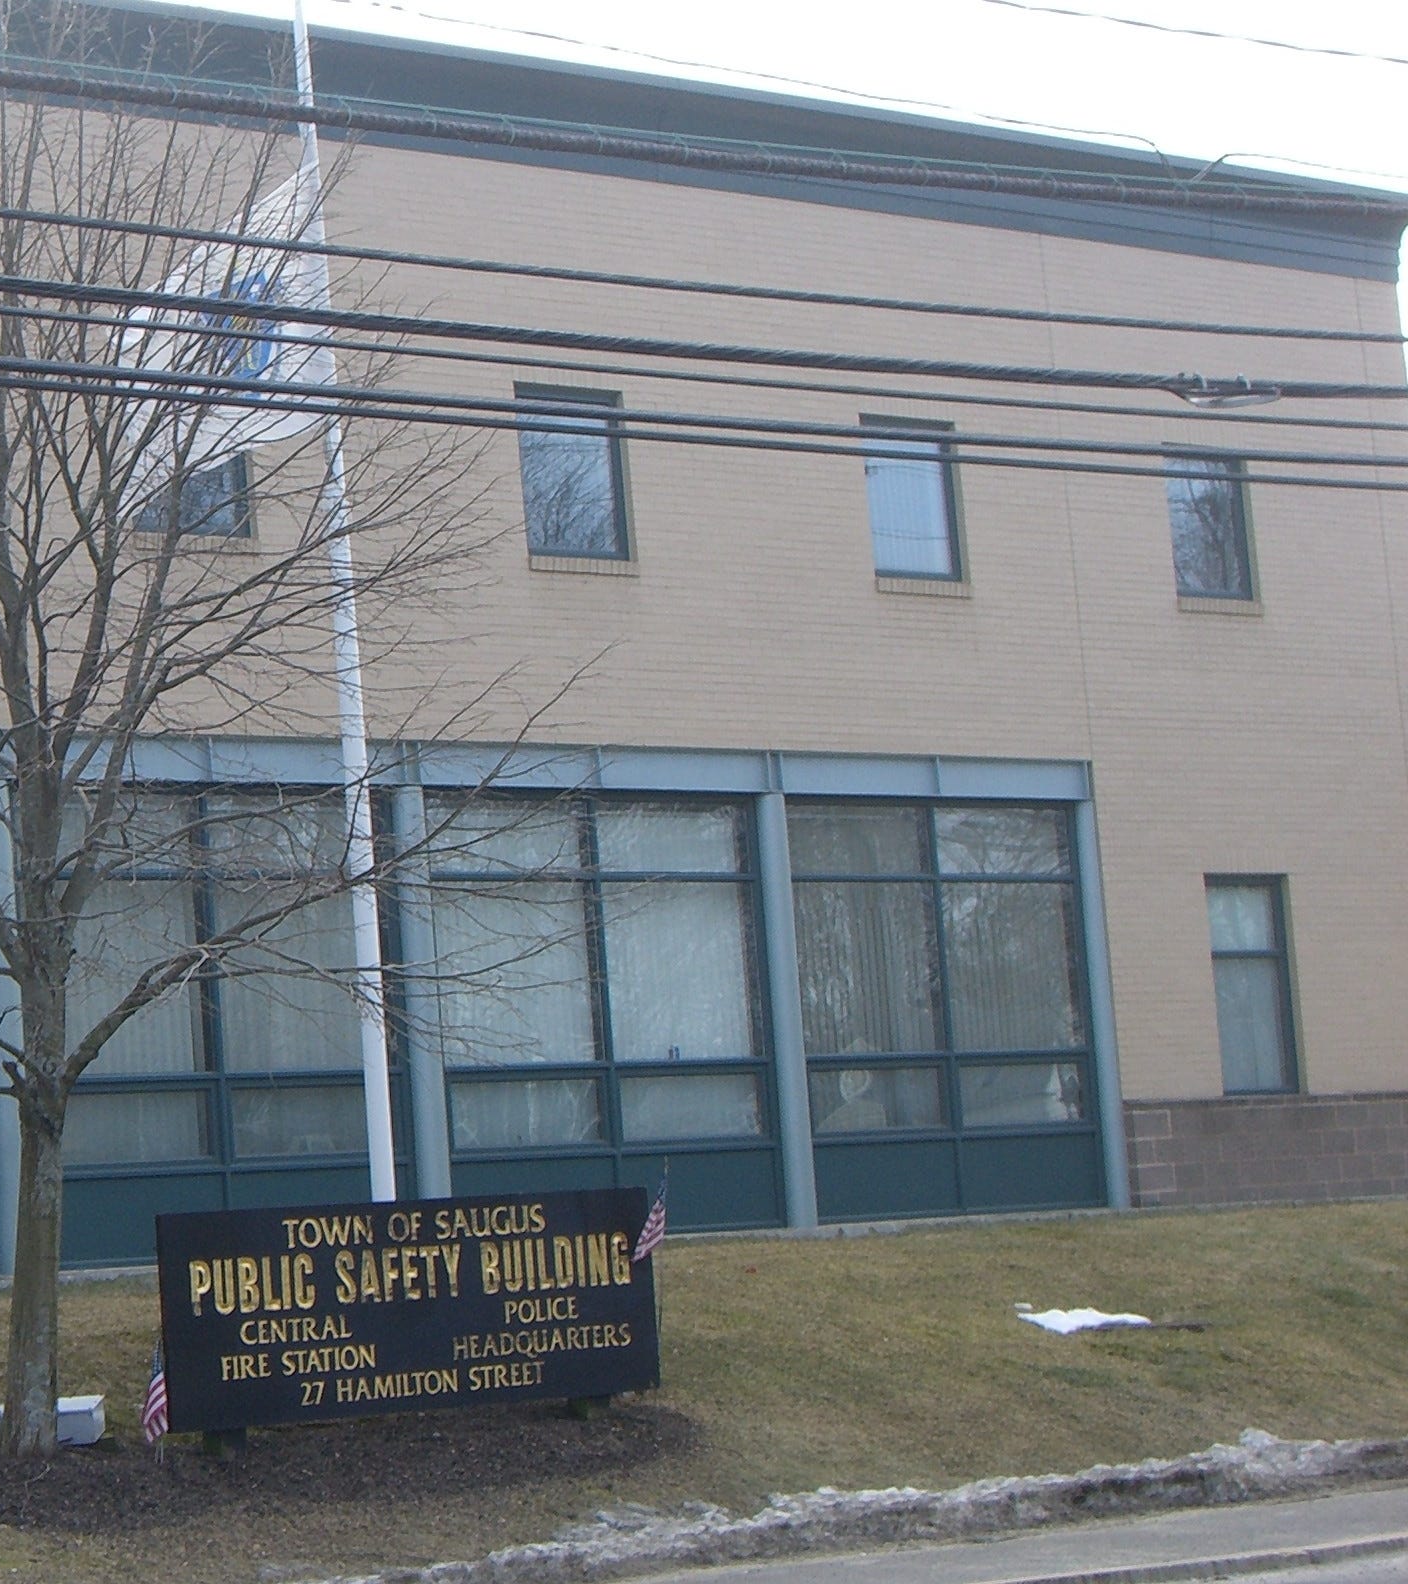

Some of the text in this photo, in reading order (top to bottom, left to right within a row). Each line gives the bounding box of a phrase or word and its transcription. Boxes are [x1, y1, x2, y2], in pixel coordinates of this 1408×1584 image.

[282, 1203, 546, 1249] TOWN OF SAUGUS
[188, 1232, 631, 1318] PUBLIC SAFETY BUILDING
[240, 1314, 353, 1345] CENTRAL
[503, 1296, 579, 1325] POLICE
[452, 1323, 632, 1361] HEADQUARTERS
[220, 1343, 377, 1381] FIRE STATION
[300, 1361, 547, 1407] 27 HAMILTON STREET
